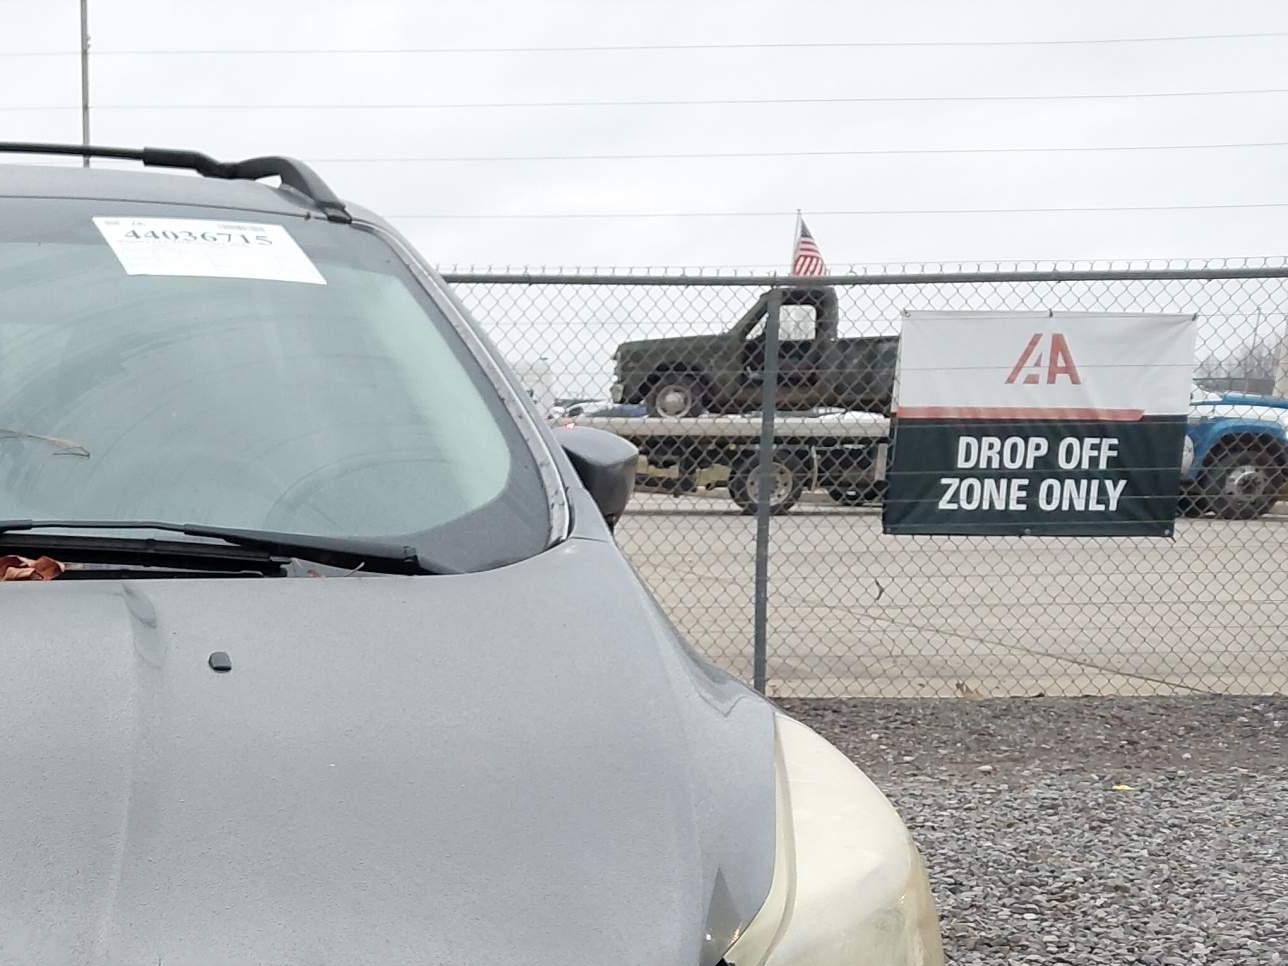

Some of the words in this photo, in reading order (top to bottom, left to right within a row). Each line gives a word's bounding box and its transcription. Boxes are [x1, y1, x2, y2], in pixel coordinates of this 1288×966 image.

[123, 228, 273, 247] 44036715
[957, 436, 1049, 470] DROP
[1058, 437, 1119, 470] OFF
[938, 477, 1029, 511] ZONE
[1038, 478, 1127, 511] ONLY
